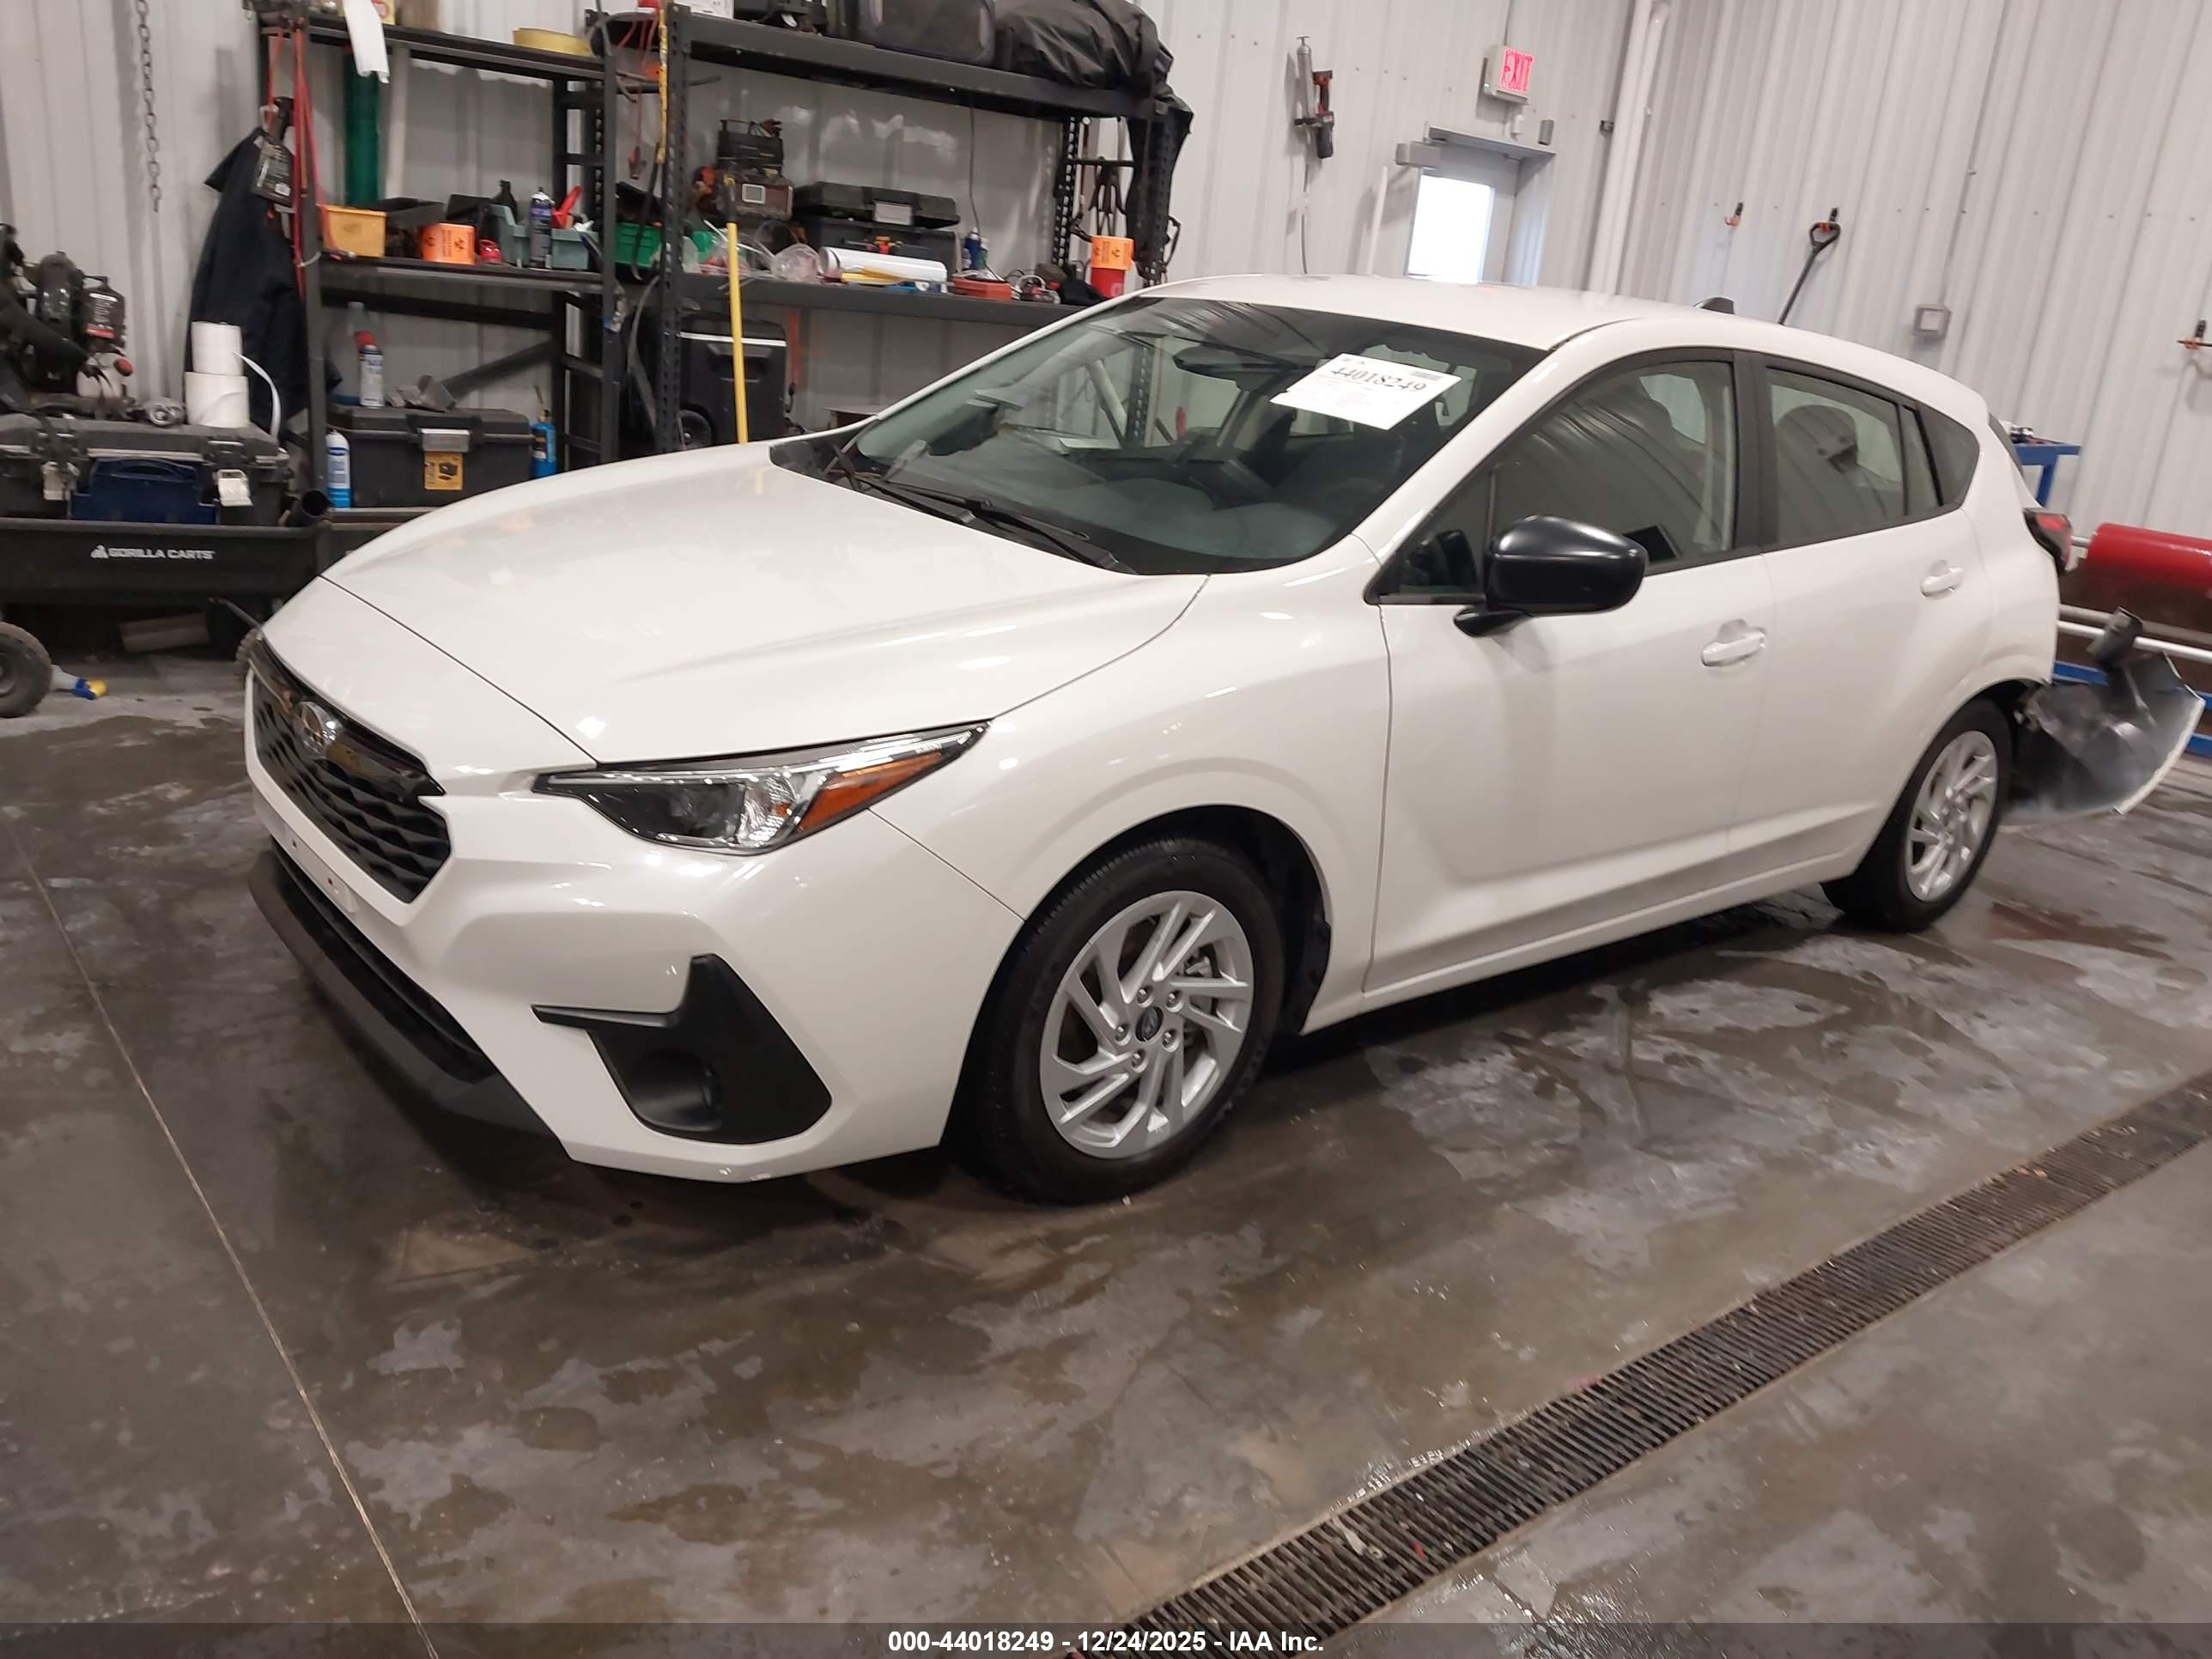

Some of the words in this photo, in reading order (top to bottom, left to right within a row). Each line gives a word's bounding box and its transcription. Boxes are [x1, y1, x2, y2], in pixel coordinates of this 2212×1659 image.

[1502, 50, 1533, 92] EXIT
[1330, 366, 1427, 392] 44018249
[107, 548, 166, 558] GORILLA
[167, 549, 214, 559] CARTS
